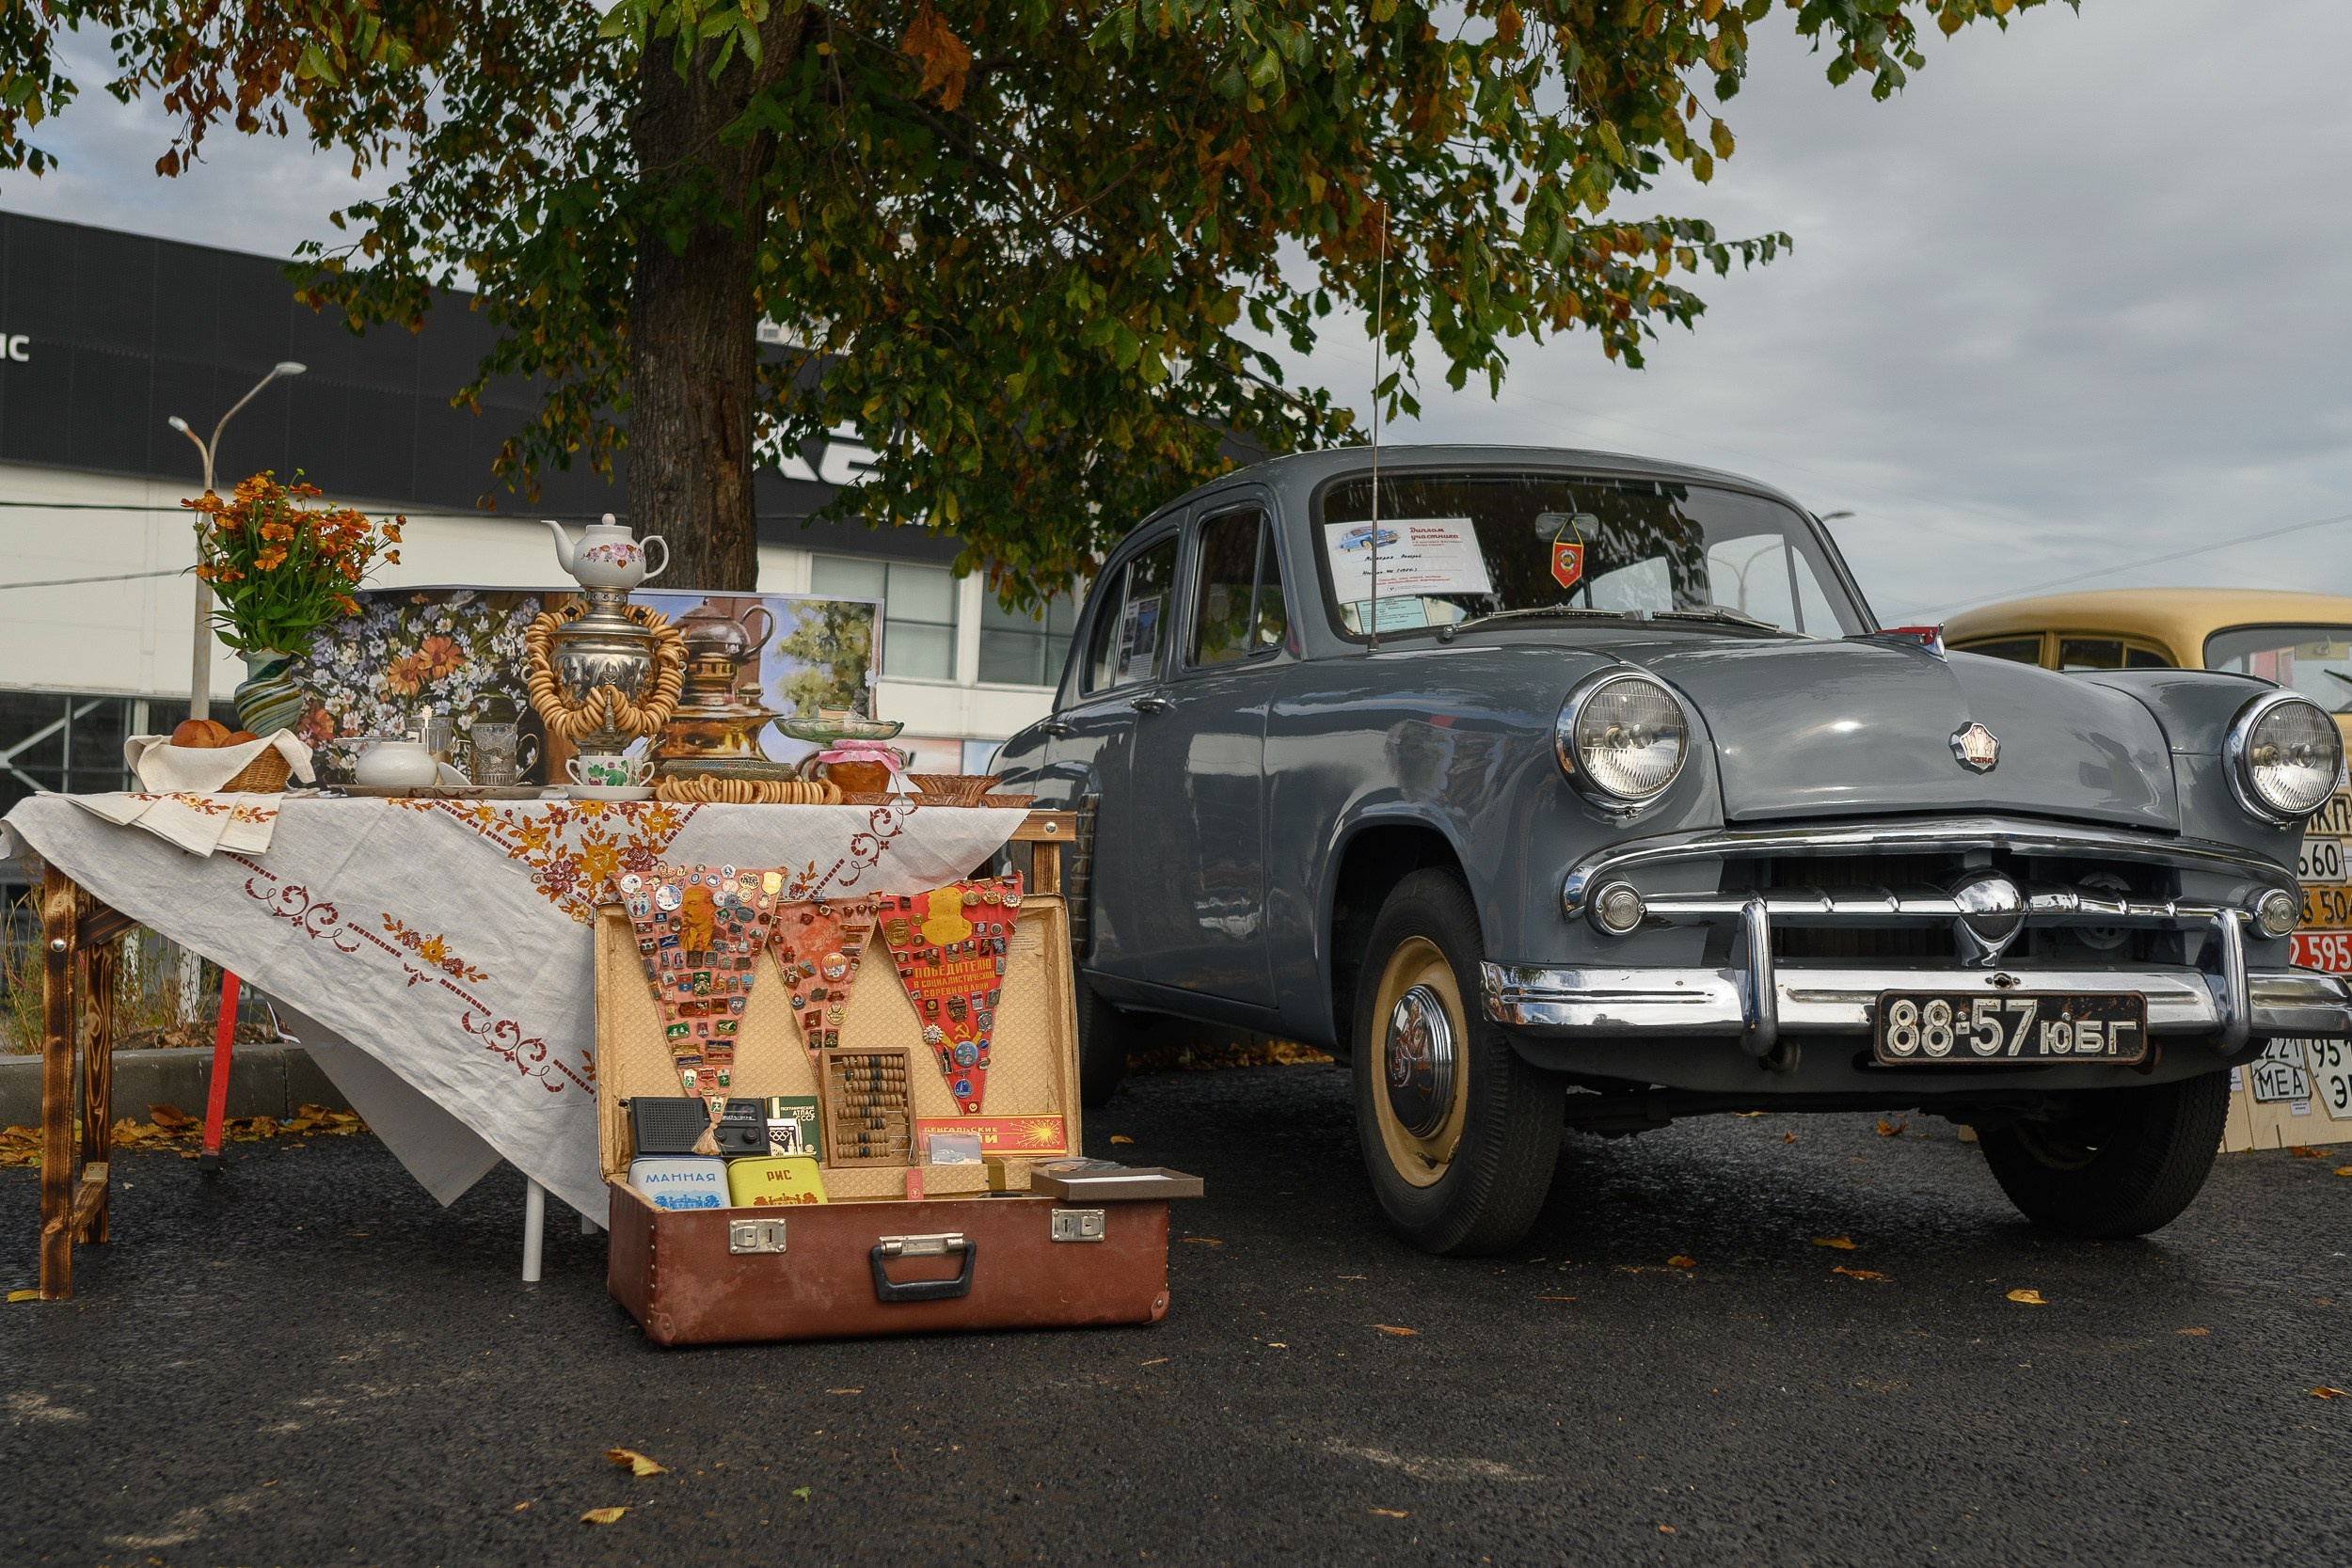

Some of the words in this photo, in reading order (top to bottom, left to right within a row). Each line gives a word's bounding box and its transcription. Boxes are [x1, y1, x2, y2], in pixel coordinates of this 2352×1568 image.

[0, 332, 30, 362] С
[2319, 890, 2352, 925] 50
[914, 958, 993, 978] ПОБЕДИТЕЛЮ
[914, 980, 919, 989] В
[921, 970, 995, 989] СОЦИАЛИСТИЧЕСКОМ
[1886, 997, 2039, 1057] 88-57
[2040, 1020, 2137, 1055] ЮБГ
[2312, 1039, 2352, 1068] 95
[2257, 1068, 2304, 1098] МЕА
[2329, 1074, 2352, 1109] Э
[645, 1172, 716, 1184] МАННАЯ
[766, 1169, 792, 1182] РИС
